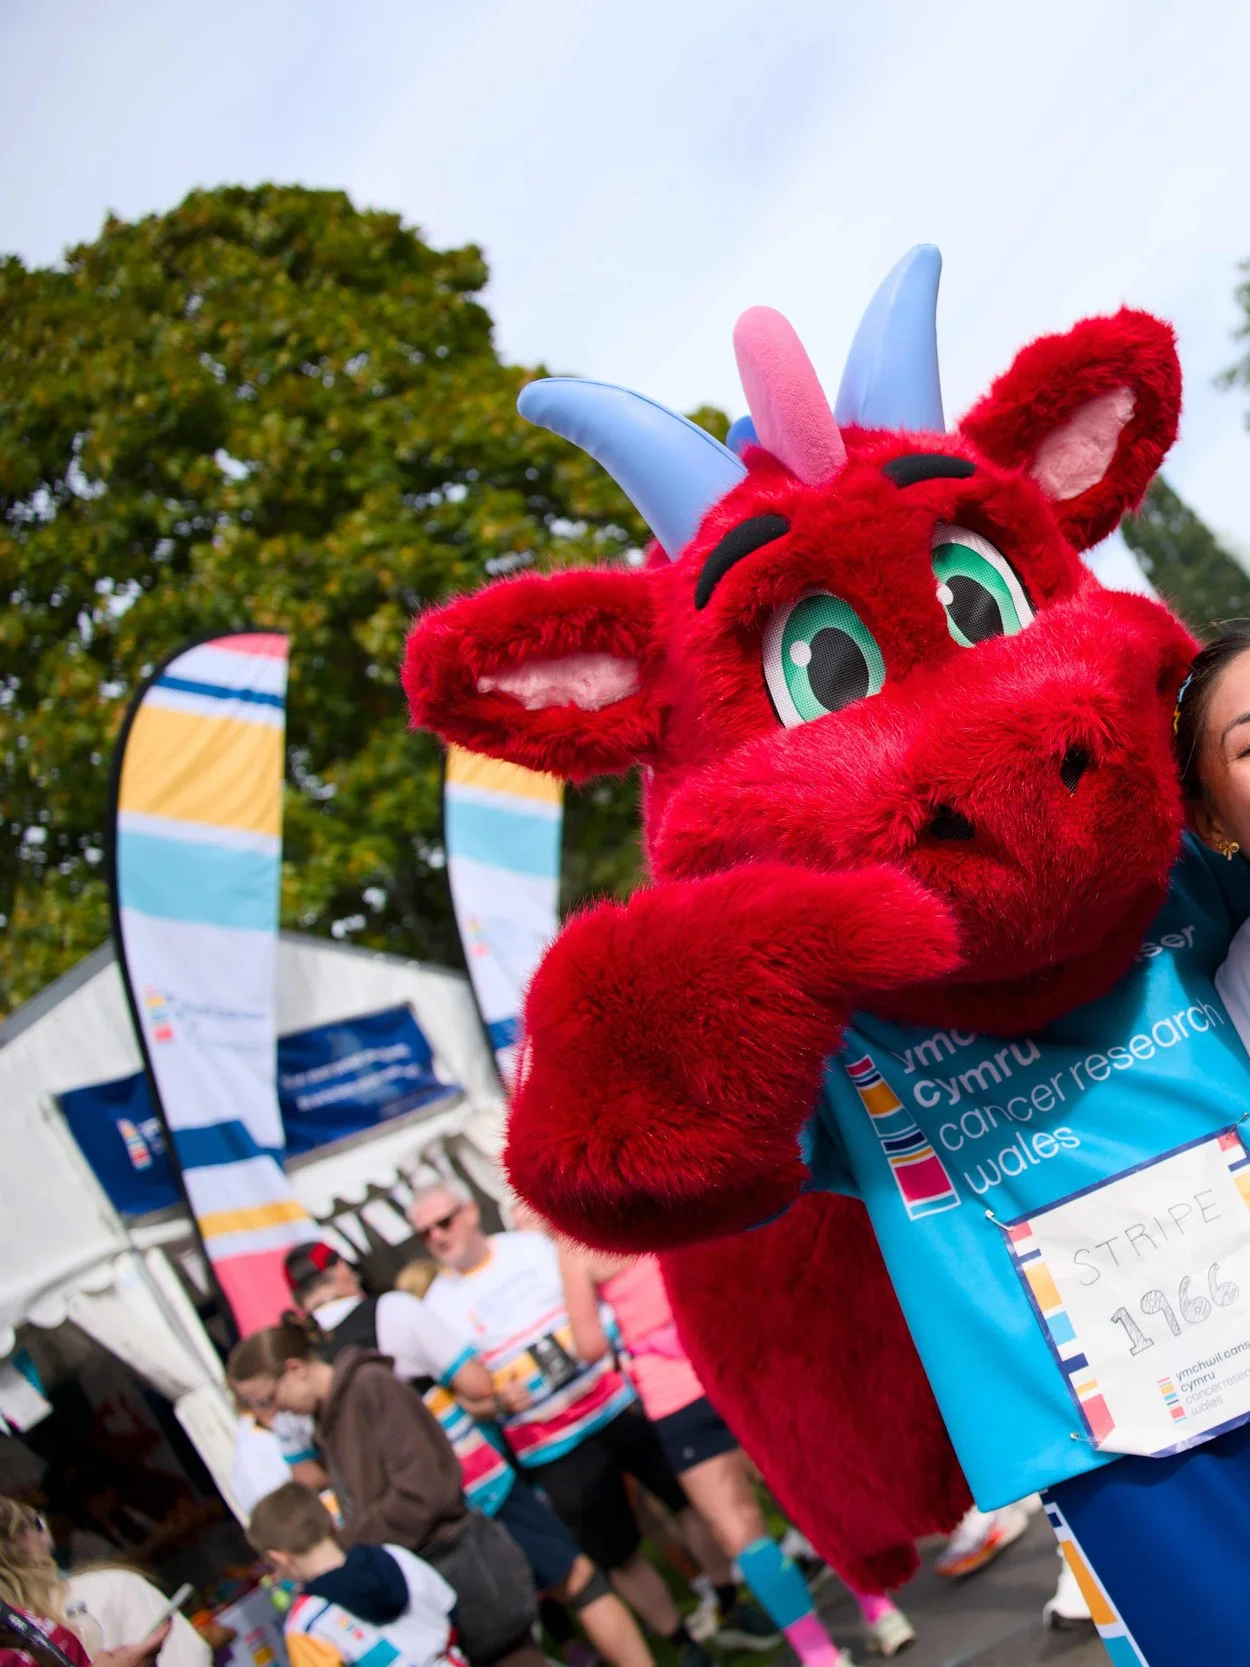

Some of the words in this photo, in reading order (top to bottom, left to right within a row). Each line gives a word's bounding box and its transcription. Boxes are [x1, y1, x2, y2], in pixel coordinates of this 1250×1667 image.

[1135, 925, 1195, 962] ser
[912, 1037, 1042, 1108] cymru
[938, 1071, 1066, 1152] cancer
[1069, 997, 1225, 1091] research
[963, 1126, 1081, 1195] wales
[1073, 1188, 1221, 1287] STRIPE
[1110, 1262, 1240, 1357] 1966
[1175, 1352, 1223, 1382] ymchwil
[1180, 1371, 1216, 1393] cymru
[1185, 1382, 1223, 1405] cancer
[1190, 1395, 1224, 1417] wales
